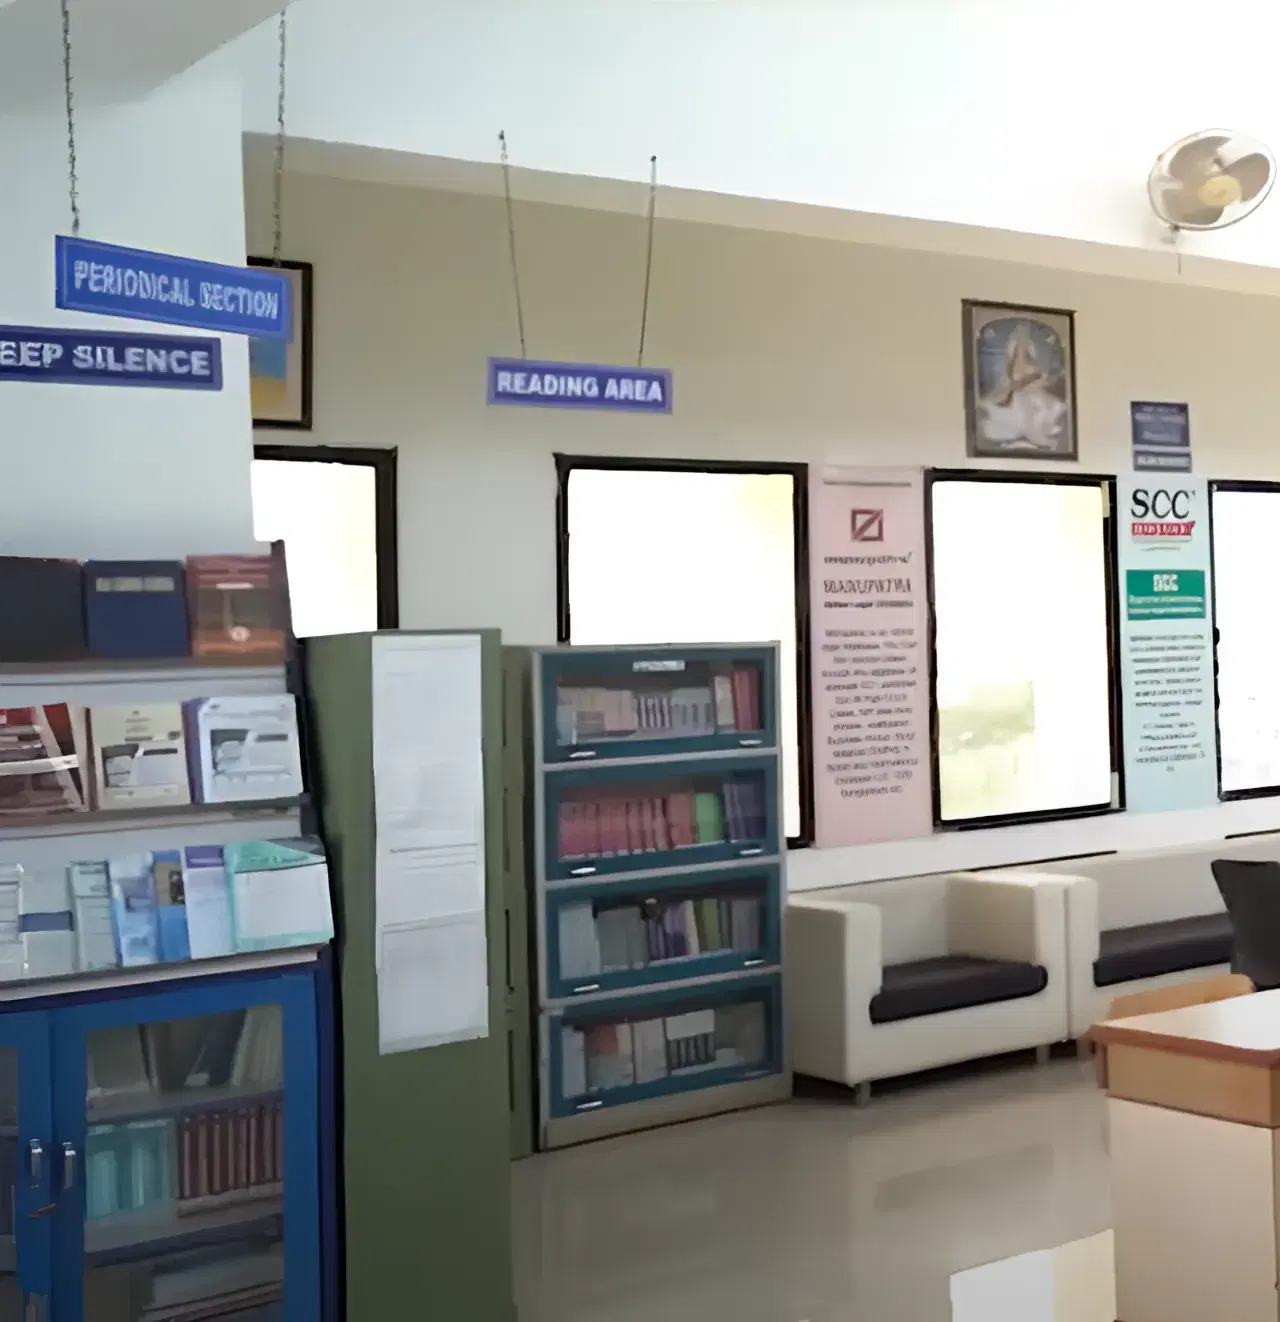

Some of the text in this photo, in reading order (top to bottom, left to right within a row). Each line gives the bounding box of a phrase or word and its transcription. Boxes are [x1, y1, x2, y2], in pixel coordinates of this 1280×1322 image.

[73, 259, 278, 320] PERIODICAL SECTION
[0, 340, 211, 376] EEP SILENCE
[497, 370, 663, 403] READING AREA
[1130, 488, 1191, 520] SCC
